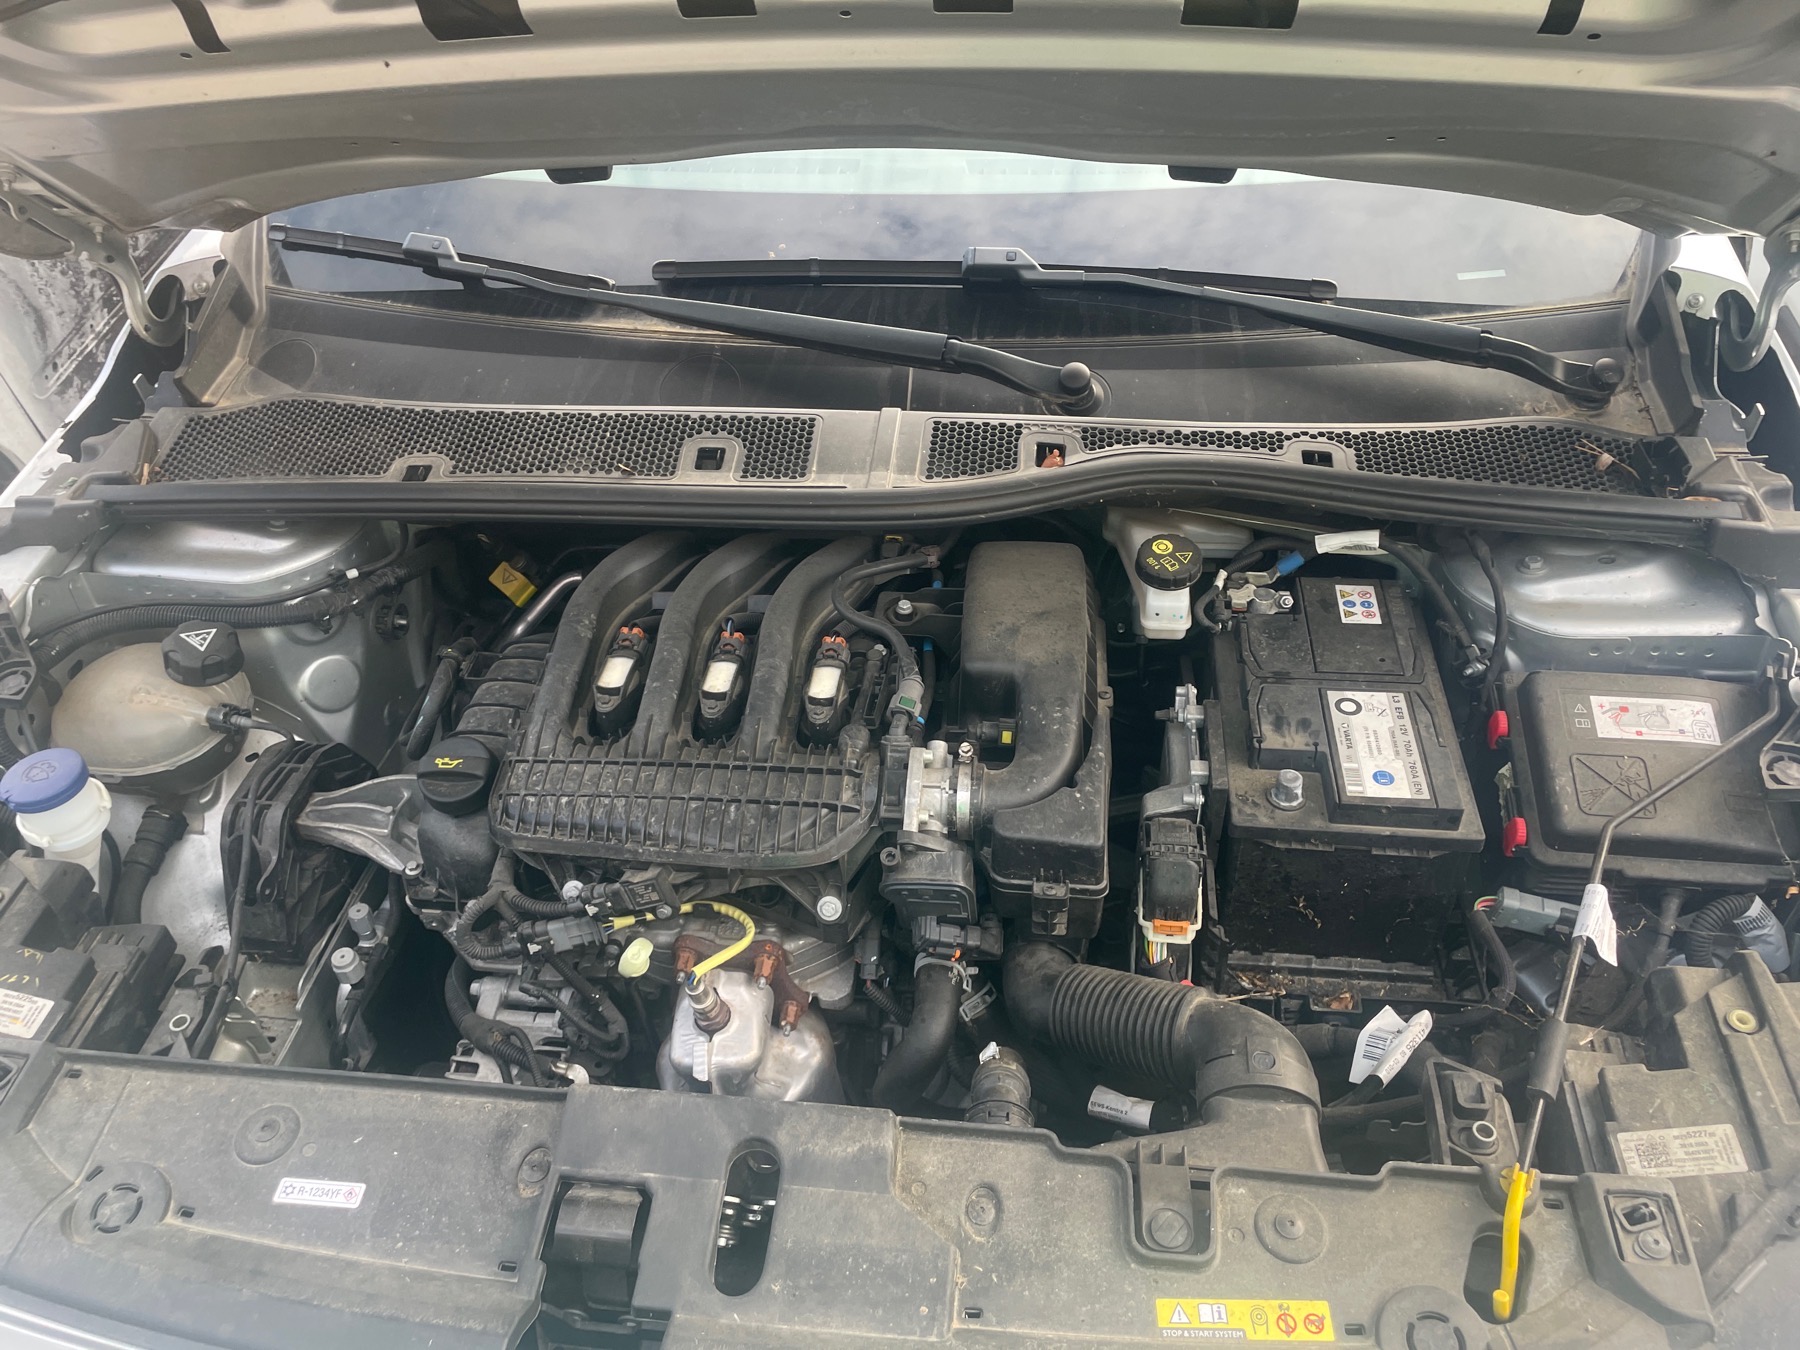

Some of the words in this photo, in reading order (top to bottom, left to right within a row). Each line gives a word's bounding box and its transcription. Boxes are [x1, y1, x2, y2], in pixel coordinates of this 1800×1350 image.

[1146, 557, 1158, 566] DOT
[1391, 695, 1401, 704] L3
[1394, 707, 1405, 720] EFB
[1398, 724, 1409, 737] 12V
[1344, 728, 1354, 750] VARTA
[1402, 740, 1413, 758] 70Ah
[1408, 761, 1420, 779] 760A
[1412, 779, 1424, 796] (EN)
[1406, 1028, 1425, 1052] 411326
[297, 1186, 343, 1199] R-1234YF
[1162, 1329, 1183, 1337] STOP
[1215, 1330, 1244, 1338] SYSTEM
